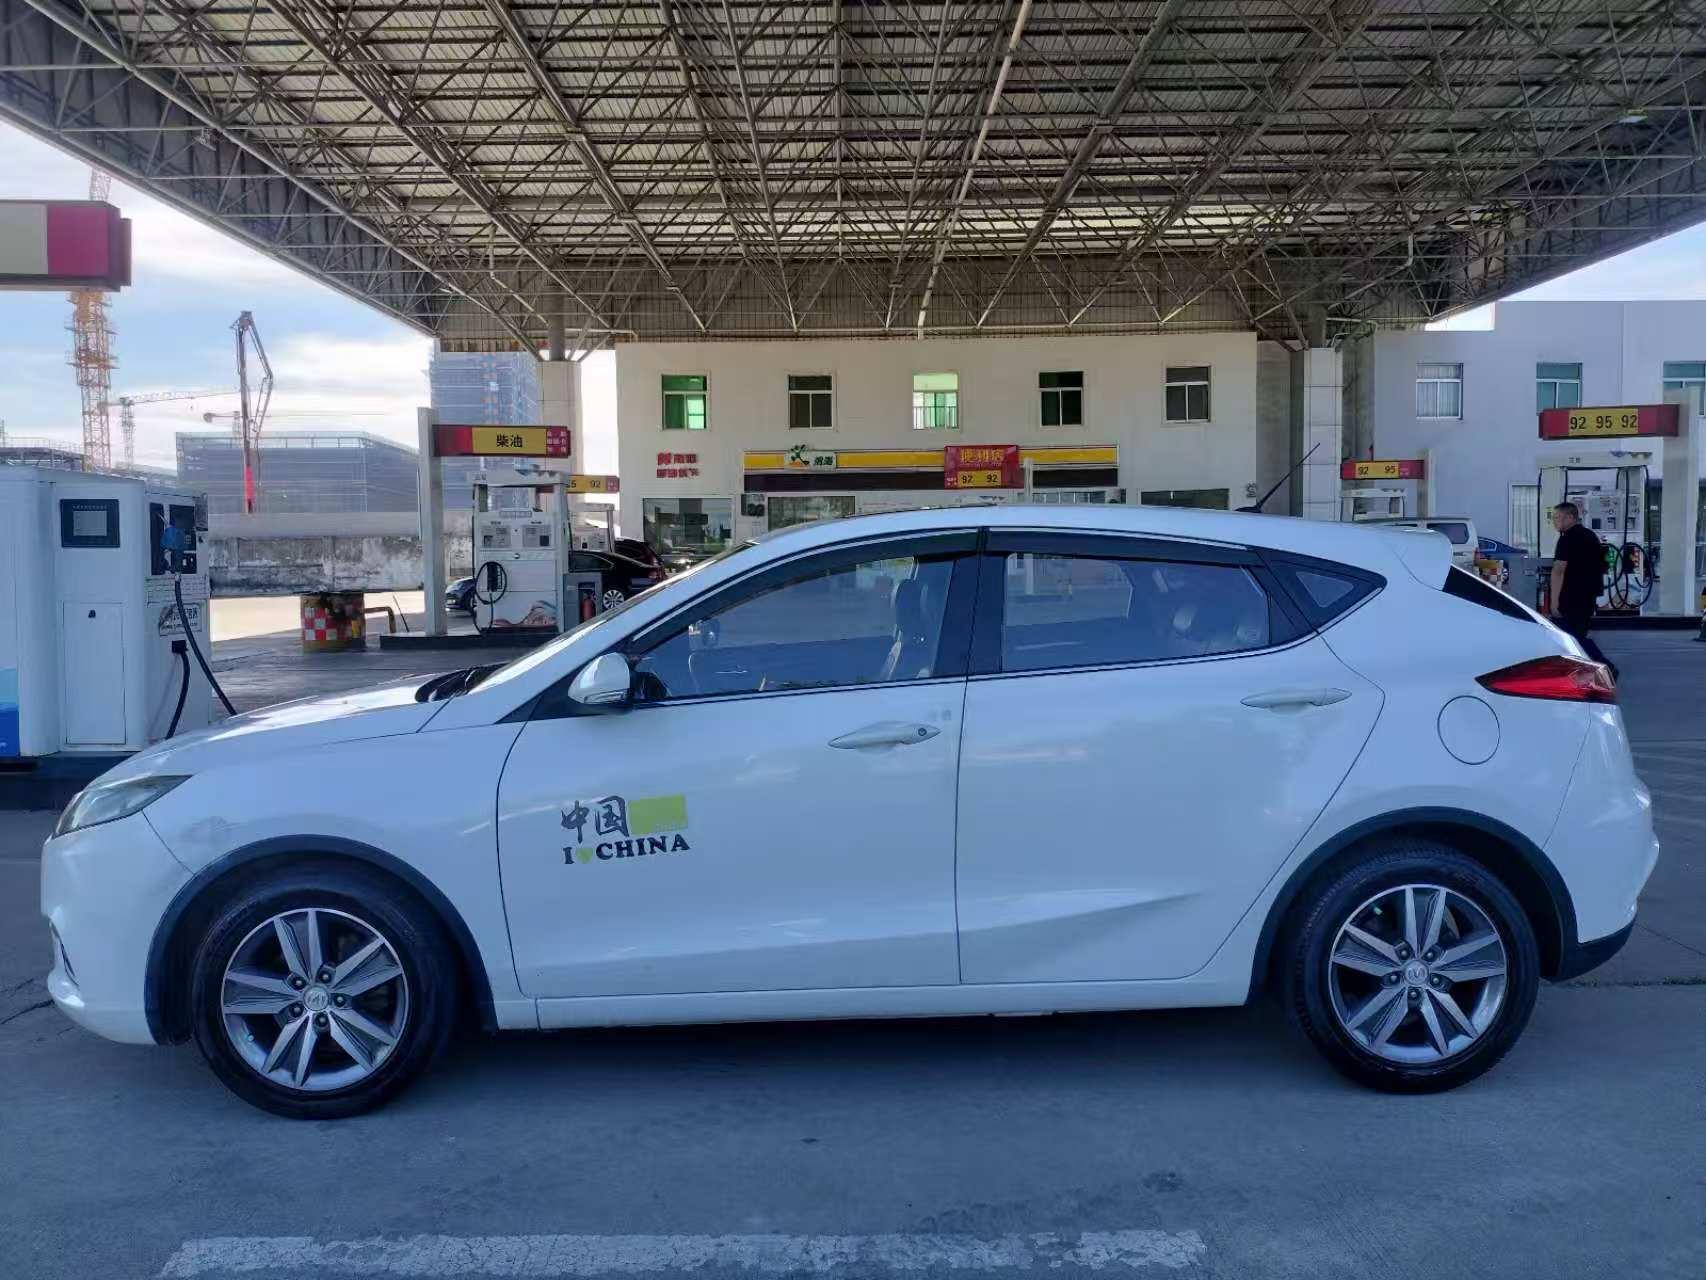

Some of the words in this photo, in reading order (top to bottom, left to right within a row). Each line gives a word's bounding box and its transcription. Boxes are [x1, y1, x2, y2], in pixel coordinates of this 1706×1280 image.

[1569, 417, 1587, 430] 92
[1595, 415, 1613, 429] 95
[1621, 414, 1638, 428] 92
[496, 434, 524, 449] 柴油
[1357, 466, 1369, 475] 92
[1384, 465, 1396, 474] 95
[961, 474, 974, 484] 92
[986, 474, 999, 483] 92
[561, 795, 630, 844] 中国
[562, 846, 575, 865] I
[595, 833, 691, 861] CHINA
